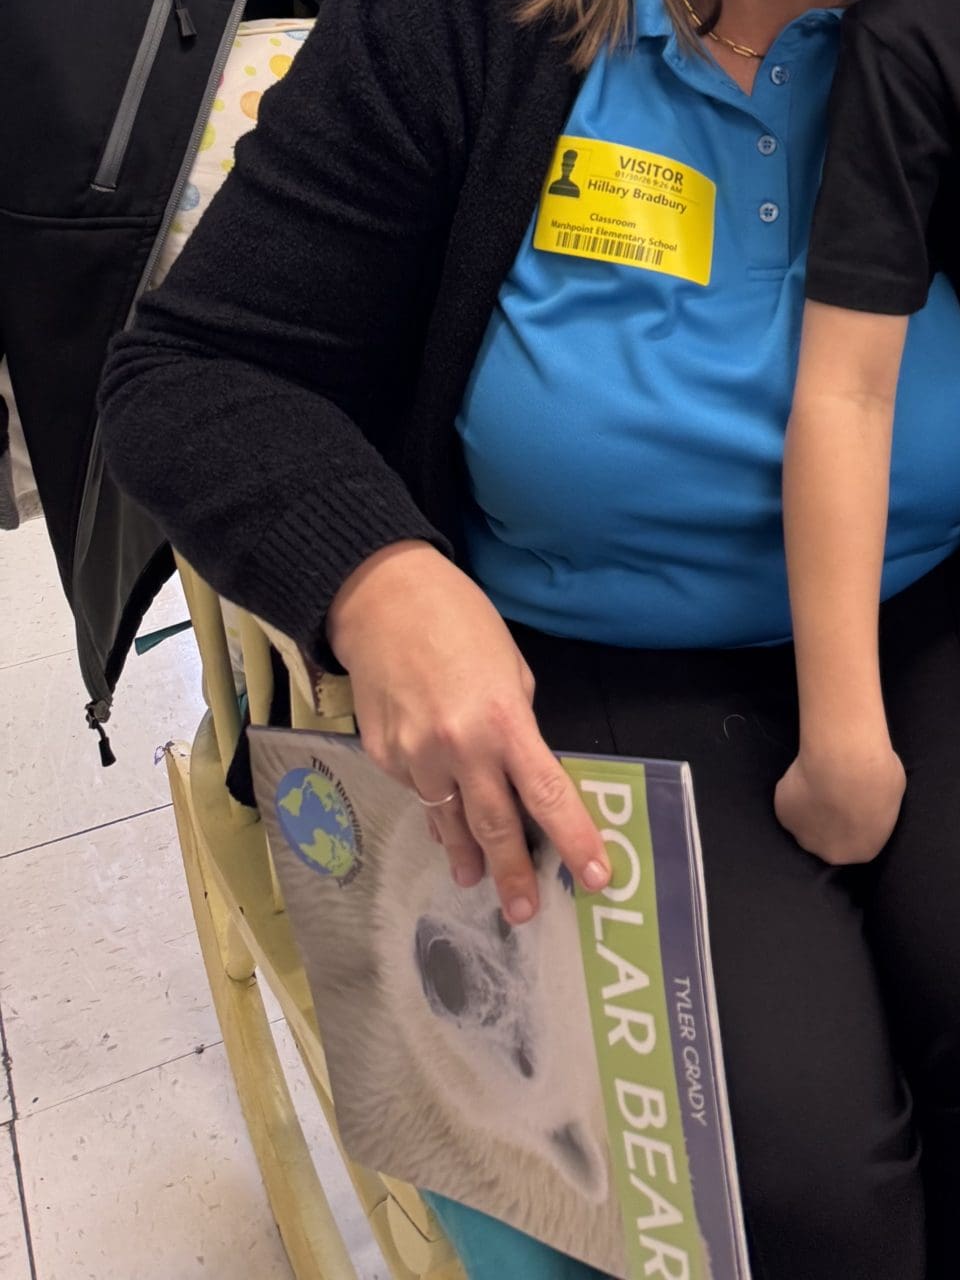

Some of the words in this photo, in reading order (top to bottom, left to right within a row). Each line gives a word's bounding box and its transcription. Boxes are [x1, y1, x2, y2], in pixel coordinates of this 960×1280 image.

[619, 155, 684, 186] VISITOR
[587, 179, 631, 200] Hillary
[633, 190, 688, 215] Bradbury
[670, 183, 683, 194] AM
[589, 213, 637, 230] Classroom
[595, 227, 647, 245] Elementary
[648, 237, 678, 252] School
[311, 756, 334, 781] This
[580, 779, 657, 1055] POLAR
[673, 976, 697, 1041] TYLER
